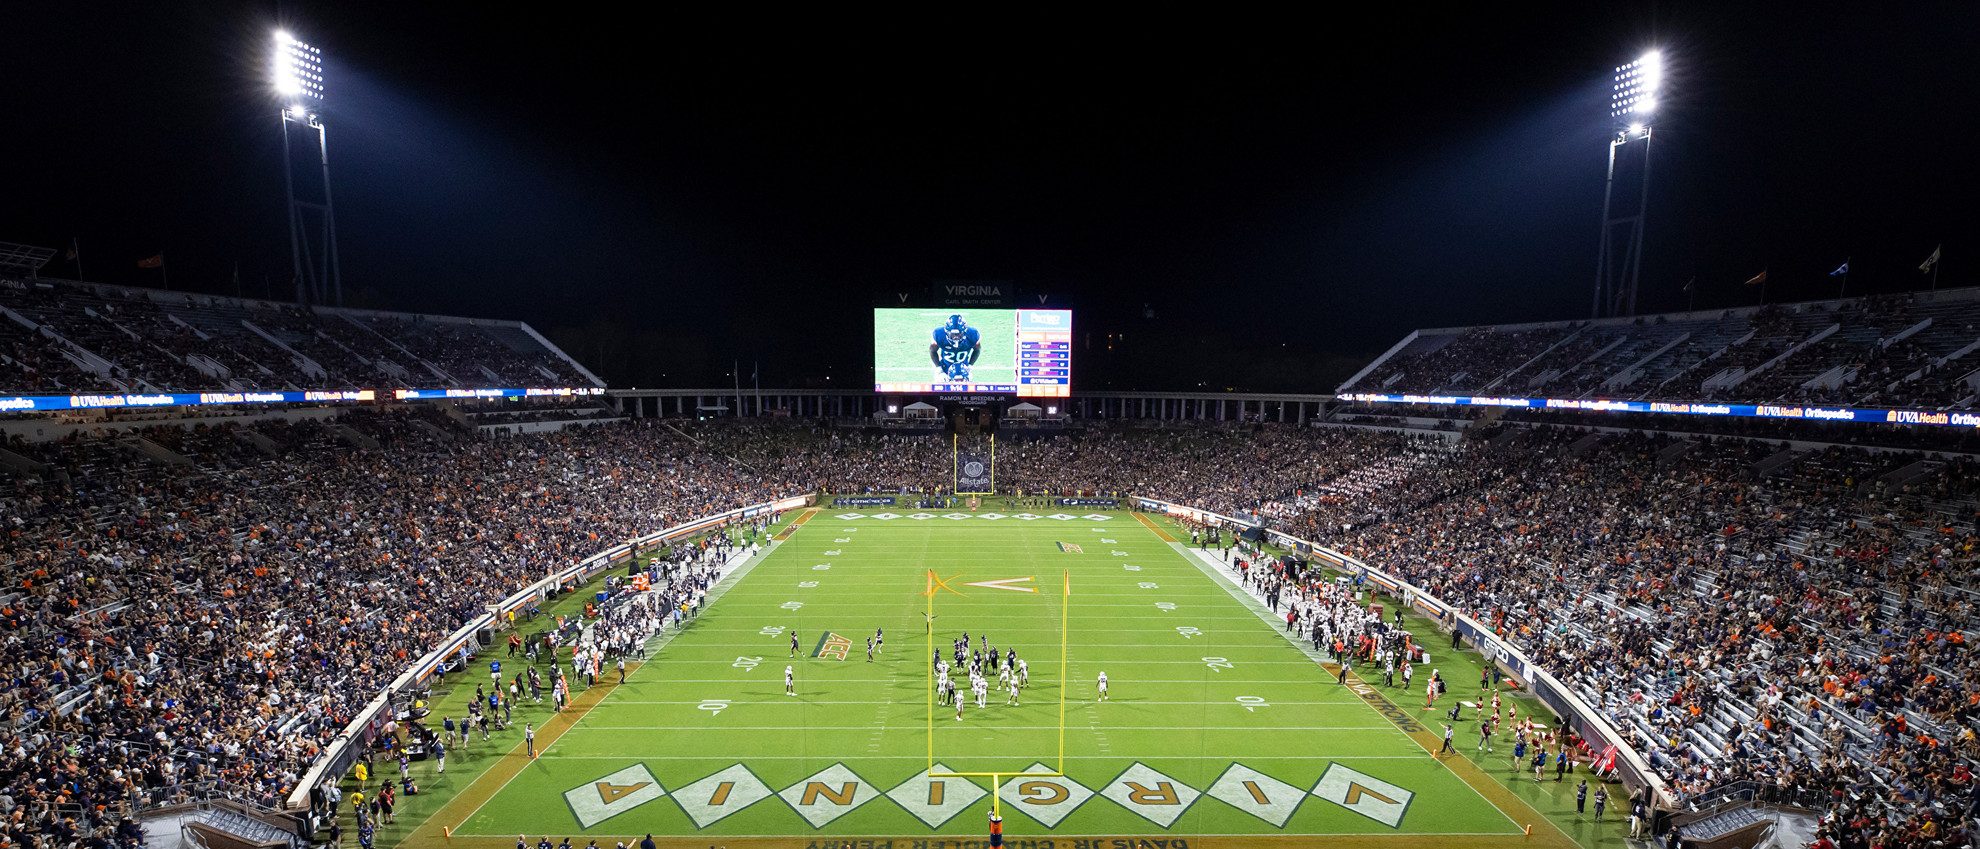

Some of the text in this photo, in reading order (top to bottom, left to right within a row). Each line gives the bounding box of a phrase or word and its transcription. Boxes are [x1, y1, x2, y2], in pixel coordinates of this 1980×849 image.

[945, 285, 1001, 296] VIRGINIA
[944, 350, 968, 363] 20
[1804, 407, 1855, 420] Orthopedics
[959, 477, 988, 488] Allstate
[817, 632, 853, 661] ACC
[732, 656, 763, 668] 20
[1201, 657, 1234, 668] 20
[697, 699, 732, 710] 10
[1235, 696, 1270, 706] 10
